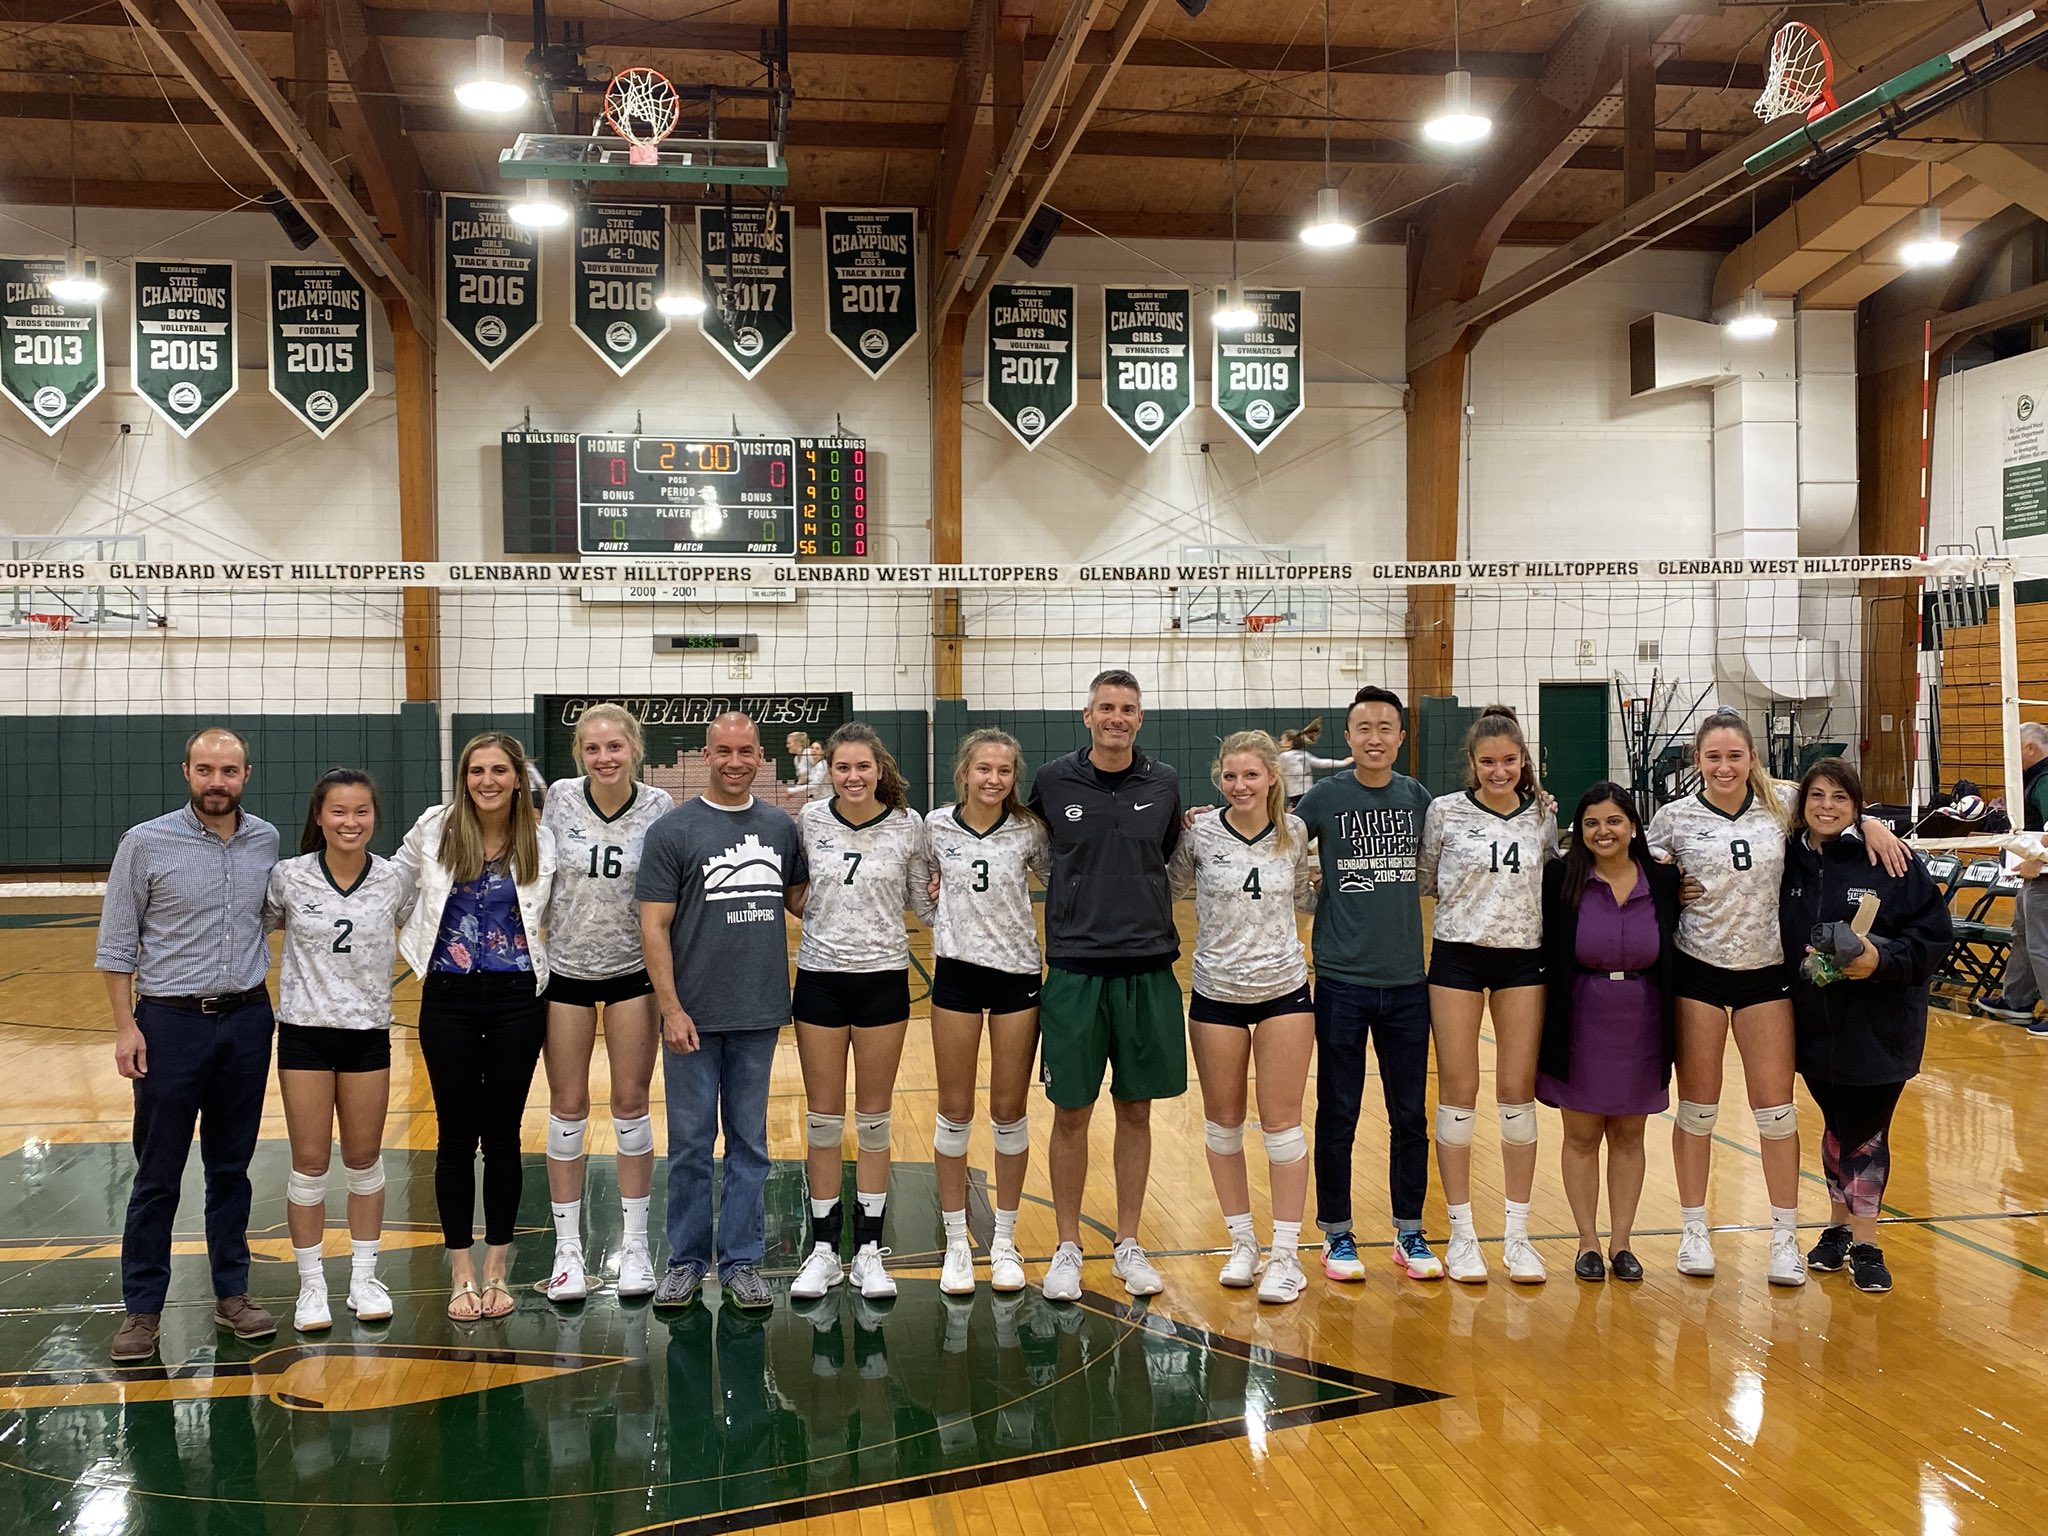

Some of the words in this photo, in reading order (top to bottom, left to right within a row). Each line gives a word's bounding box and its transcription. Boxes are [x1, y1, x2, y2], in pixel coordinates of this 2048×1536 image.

[478, 212, 507, 223] STATE
[606, 218, 634, 229] STATE
[452, 221, 532, 245] CHAMPIONS
[732, 222, 758, 232] STATE
[856, 225, 882, 234] STATE
[482, 240, 502, 248] GIRLS
[581, 227, 659, 251] CHAMPIONS
[832, 234, 907, 254] CHAMPIONS
[607, 247, 635, 260] 42-0
[731, 253, 760, 263] BOYS
[460, 258, 487, 266] TRACK
[492, 258, 499, 267] &
[502, 260, 524, 268] FIELD
[587, 264, 607, 273] BOYS
[609, 265, 654, 274] VOLLEYBALL
[169, 276, 198, 287] STATE
[304, 279, 333, 289] STATE
[459, 274, 524, 305] 2016
[589, 280, 652, 310] 2016
[142, 286, 226, 309] CHAMPIONS
[278, 289, 360, 311] CHAMPIONS
[842, 285, 901, 312] 2017
[1018, 298, 1043, 308] STATE
[31, 304, 65, 316] GIRLS
[1134, 302, 1160, 311] STATE
[168, 308, 200, 320] BOYS
[306, 309, 333, 321] 14-0
[995, 307, 1067, 329] CHAMPIONS
[15, 319, 42, 327] CROSS
[45, 320, 81, 328] COUNTRY
[161, 324, 208, 332] VOLLEYBALL
[1111, 311, 1184, 332] CHAMPIONS
[1258, 312, 1295, 333] PIONS
[299, 327, 341, 335] FOOTBALL
[1016, 327, 1045, 338] BOYS
[1132, 332, 1163, 343] GIRLS
[1244, 332, 1275, 343] GIRLS
[14, 334, 82, 365] 2013
[1010, 342, 1051, 350] VOLLEYBALL
[1237, 347, 1281, 355] GYMNASTICS
[150, 339, 218, 370] 2015
[287, 343, 353, 372] 2015
[1001, 356, 1059, 385] 2017
[1118, 361, 1177, 390] 2018
[1230, 361, 1289, 390] 2019
[506, 434, 521, 443] NO
[525, 434, 552, 443] KILLS
[553, 434, 576, 443] DIGS
[800, 439, 813, 448] NO
[818, 439, 843, 449] KILLS
[843, 439, 865, 449] DIGS
[587, 440, 626, 453] HOME
[740, 443, 791, 456] VISITOR
[806, 450, 816, 463] 4
[830, 450, 839, 464] 0
[854, 450, 863, 465] 0
[610, 458, 626, 485] 0
[770, 461, 786, 487] 0
[807, 467, 816, 481] 7
[831, 468, 840, 482] 0
[855, 468, 864, 483] 0
[668, 476, 688, 484] POSS
[602, 490, 635, 500] BONUS
[661, 487, 695, 497] PERIOD
[740, 493, 772, 502] BONUS
[806, 486, 816, 499] 9
[831, 486, 840, 500] 0
[855, 486, 864, 500] 0
[597, 507, 628, 517] FOULS
[656, 508, 691, 518] PLAYER
[748, 509, 777, 519] FOULS
[804, 504, 816, 518] 12
[831, 504, 840, 518] 0
[855, 504, 864, 518] 0
[613, 519, 625, 540] 0
[763, 521, 775, 542] 0
[804, 523, 817, 536] 14
[831, 523, 840, 536] 0
[855, 523, 864, 537] 0
[598, 542, 629, 551] POINTS
[673, 543, 703, 552] MATCH
[748, 544, 777, 552] POINTS
[800, 540, 817, 554] 56
[832, 540, 840, 554] 0
[855, 540, 864, 554] 0
[110, 563, 216, 580] GLENBARD
[222, 565, 284, 580] WEST
[291, 565, 425, 581] HILLTOPPERS
[449, 565, 551, 581] GLENBARD
[558, 566, 618, 581] WEST
[624, 567, 752, 582] HILLTOPPERS
[1373, 563, 1462, 579] GLENBARD
[1467, 563, 1520, 578] WEST
[1525, 562, 1639, 577] HILLTOPPERS
[1658, 560, 1743, 575] GLENBARD
[1749, 560, 1799, 574] WEST
[1803, 558, 1912, 574] HILLTOPPERS
[774, 567, 870, 582] GLENBARD
[876, 567, 932, 582] WEST
[938, 567, 1059, 582] HILLTOPPERS
[1080, 567, 1171, 582] GLENBARD
[1177, 566, 1230, 581] WEST
[1236, 566, 1352, 581] HILLTOPPERS
[630, 586, 656, 597] 2000
[672, 587, 697, 597] 2001
[562, 698, 730, 726] GNBARD
[740, 697, 829, 724] WEST
[1334, 809, 1413, 839] TARGET
[1351, 836, 1418, 858] SUCCESS
[588, 844, 624, 879] 16
[1489, 840, 1521, 874] 14
[1730, 839, 1752, 871] 8
[843, 852, 862, 885] 7
[1336, 858, 1369, 871] GLENBARD
[1369, 857, 1387, 869] WEST
[1387, 857, 1403, 868] HIGH
[971, 859, 989, 893] 3
[1242, 867, 1262, 900] 4
[747, 901, 757, 909] THE
[726, 909, 775, 924] HILLTOPPERS
[332, 919, 353, 953] 2
